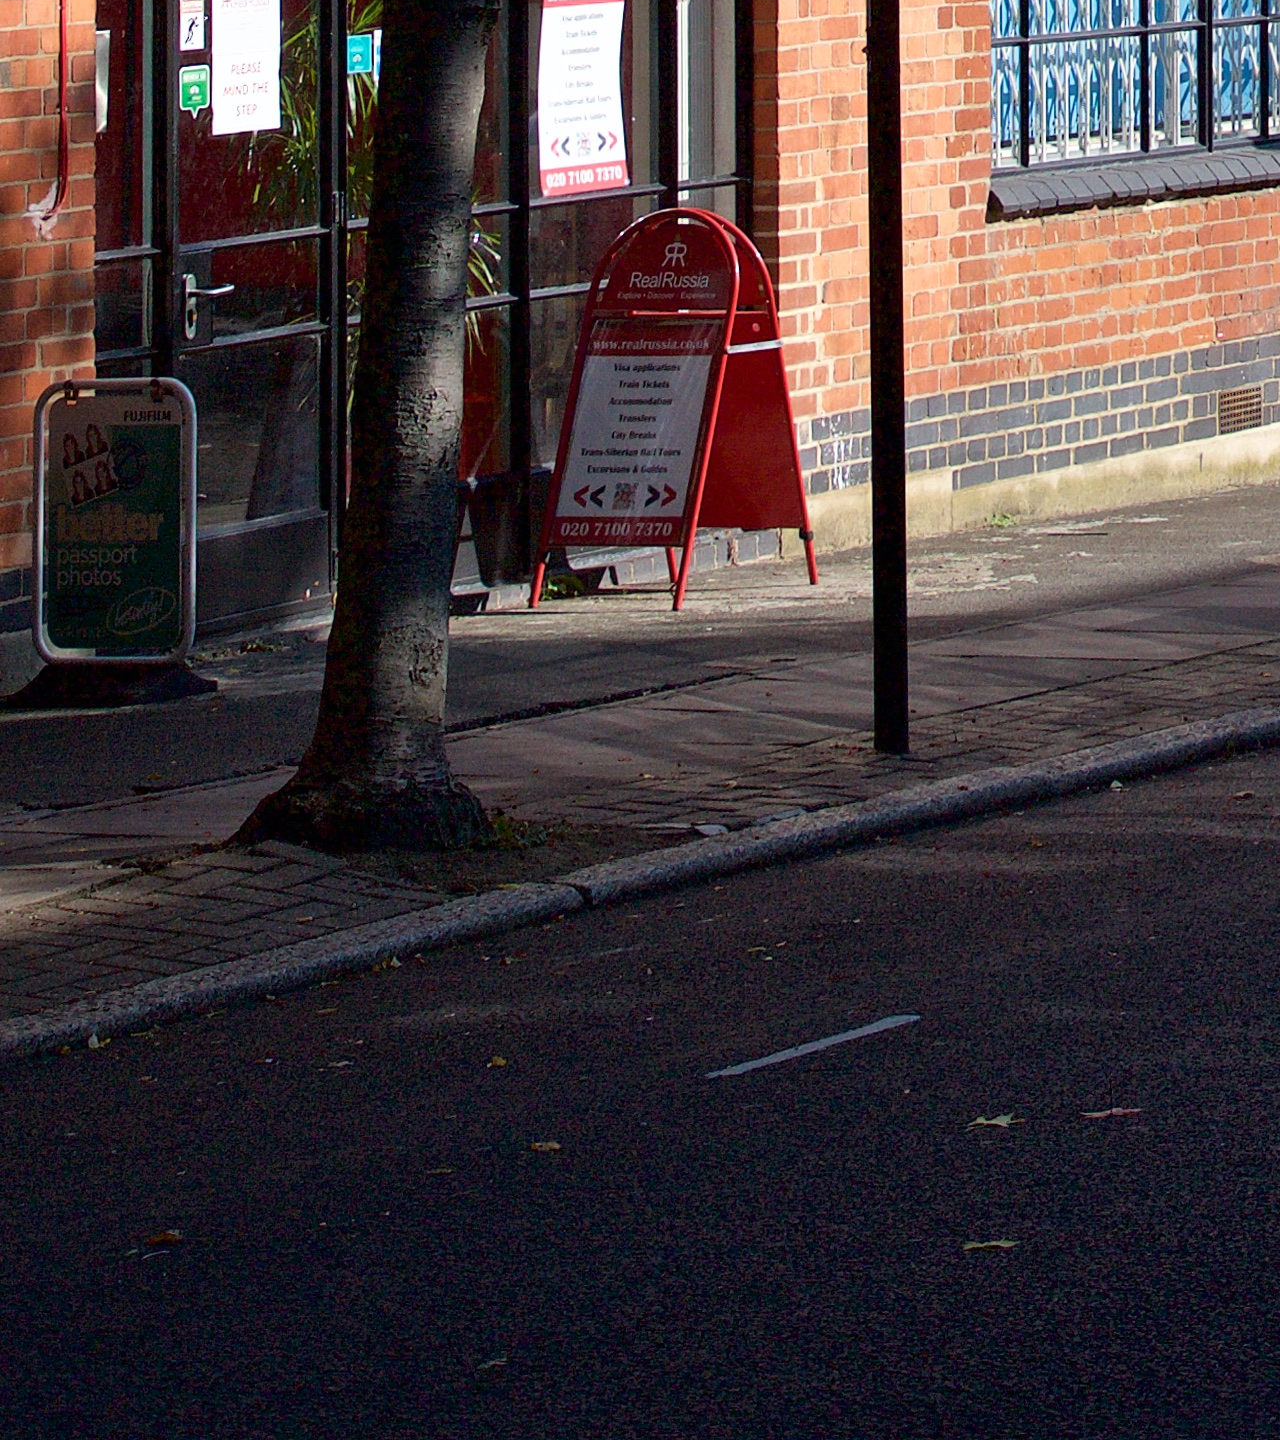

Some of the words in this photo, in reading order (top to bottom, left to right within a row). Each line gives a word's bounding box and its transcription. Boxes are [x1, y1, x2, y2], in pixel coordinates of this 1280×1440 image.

[230, 61, 262, 75] PLEASE
[223, 84, 249, 97] MIND
[252, 81, 269, 94] THE
[236, 103, 257, 117] STEP
[546, 173, 566, 188] 020
[568, 169, 594, 185] 7100
[596, 165, 623, 181] 7370
[629, 271, 709, 288] RealRussia
[593, 339, 709, 350] www.realrussia.co.uk
[614, 362, 631, 372] Visa
[633, 363, 681, 373] applications
[619, 380, 640, 389] Train
[642, 380, 670, 389] Tickets
[609, 397, 673, 406] Accommodation
[124, 410, 172, 422] FUJIFILM
[619, 414, 657, 423] Transfers
[611, 431, 626, 440] City
[629, 431, 657, 440] Breaks
[581, 448, 639, 456] Trans-Siberian
[659, 448, 681, 456] Tours
[587, 465, 631, 474] Excursions
[56, 503, 165, 542] better
[561, 522, 590, 537] 020
[594, 522, 631, 536] 7100
[635, 522, 673, 537] 7370
[56, 544, 139, 570] passport
[56, 565, 122, 590] photos
